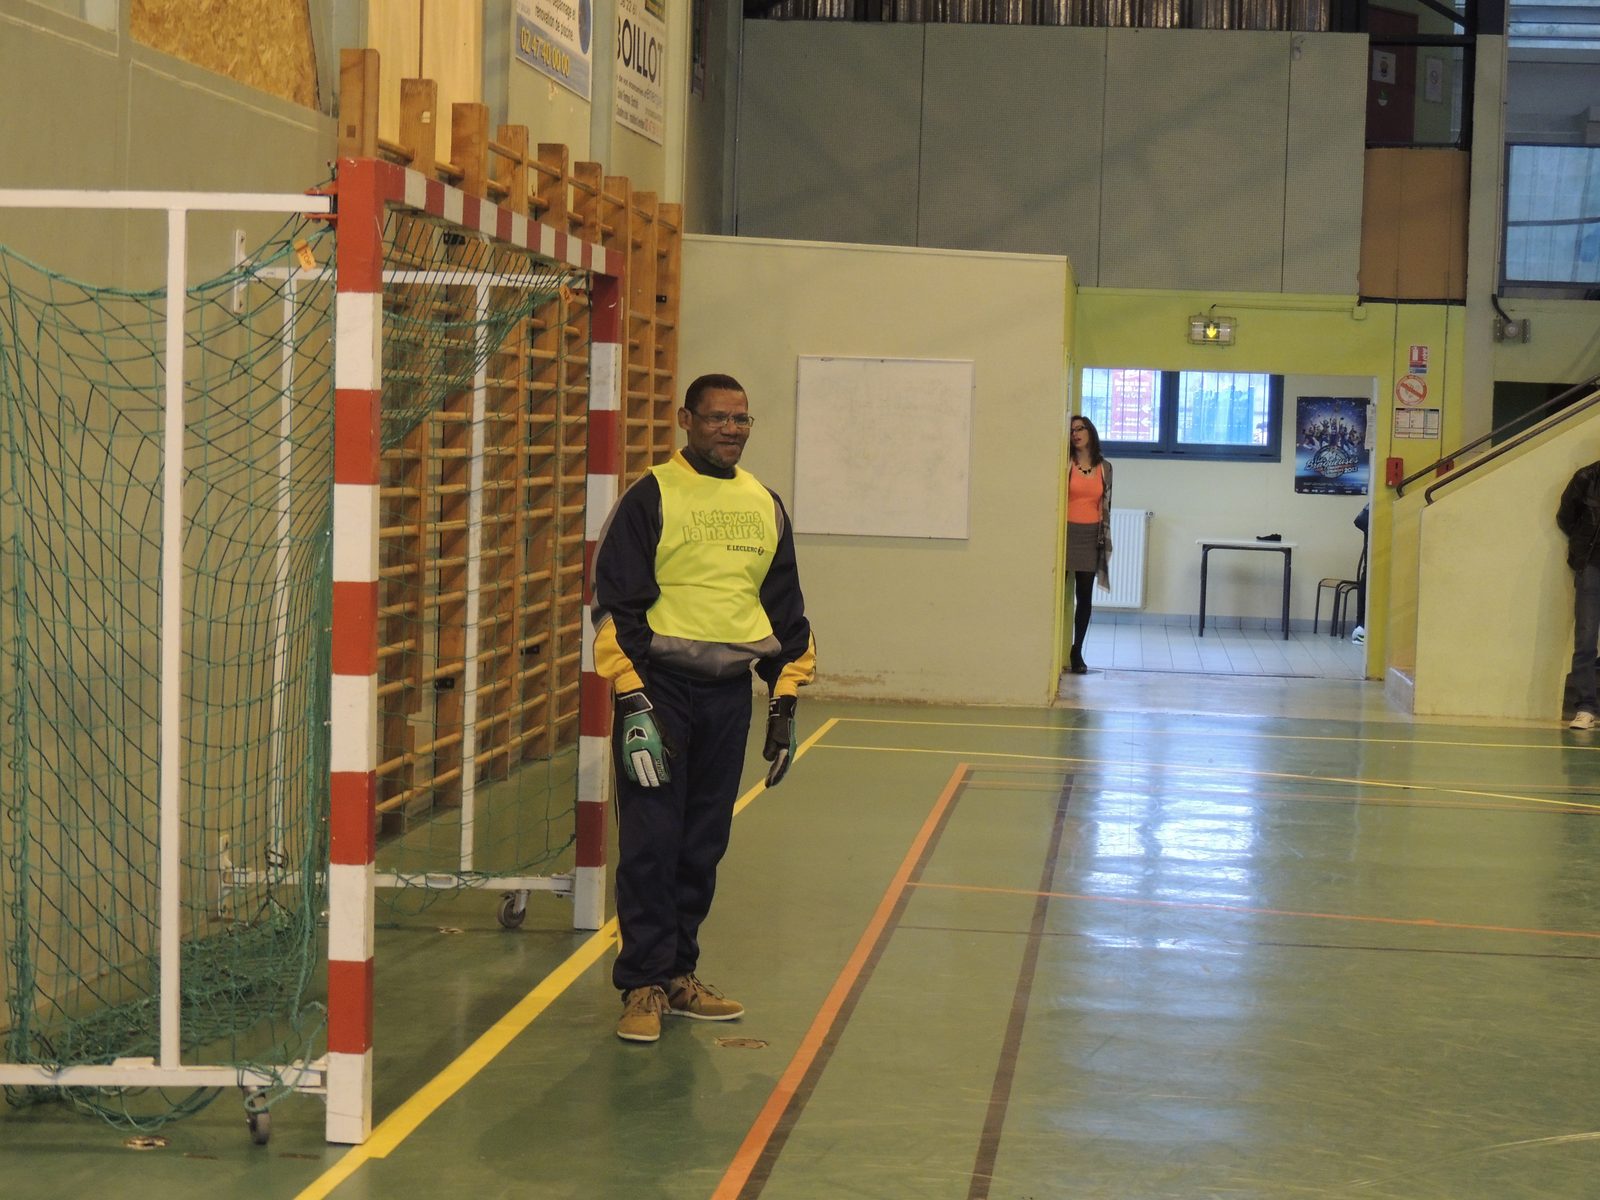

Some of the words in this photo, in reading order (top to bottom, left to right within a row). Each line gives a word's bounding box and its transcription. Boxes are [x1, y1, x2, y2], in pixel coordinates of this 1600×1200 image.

[521, 27, 530, 54] 02
[531, 35, 543, 60] 47
[1306, 457, 1359, 471] Braqueuses
[692, 511, 762, 526] Nettoyons
[683, 525, 703, 543] la
